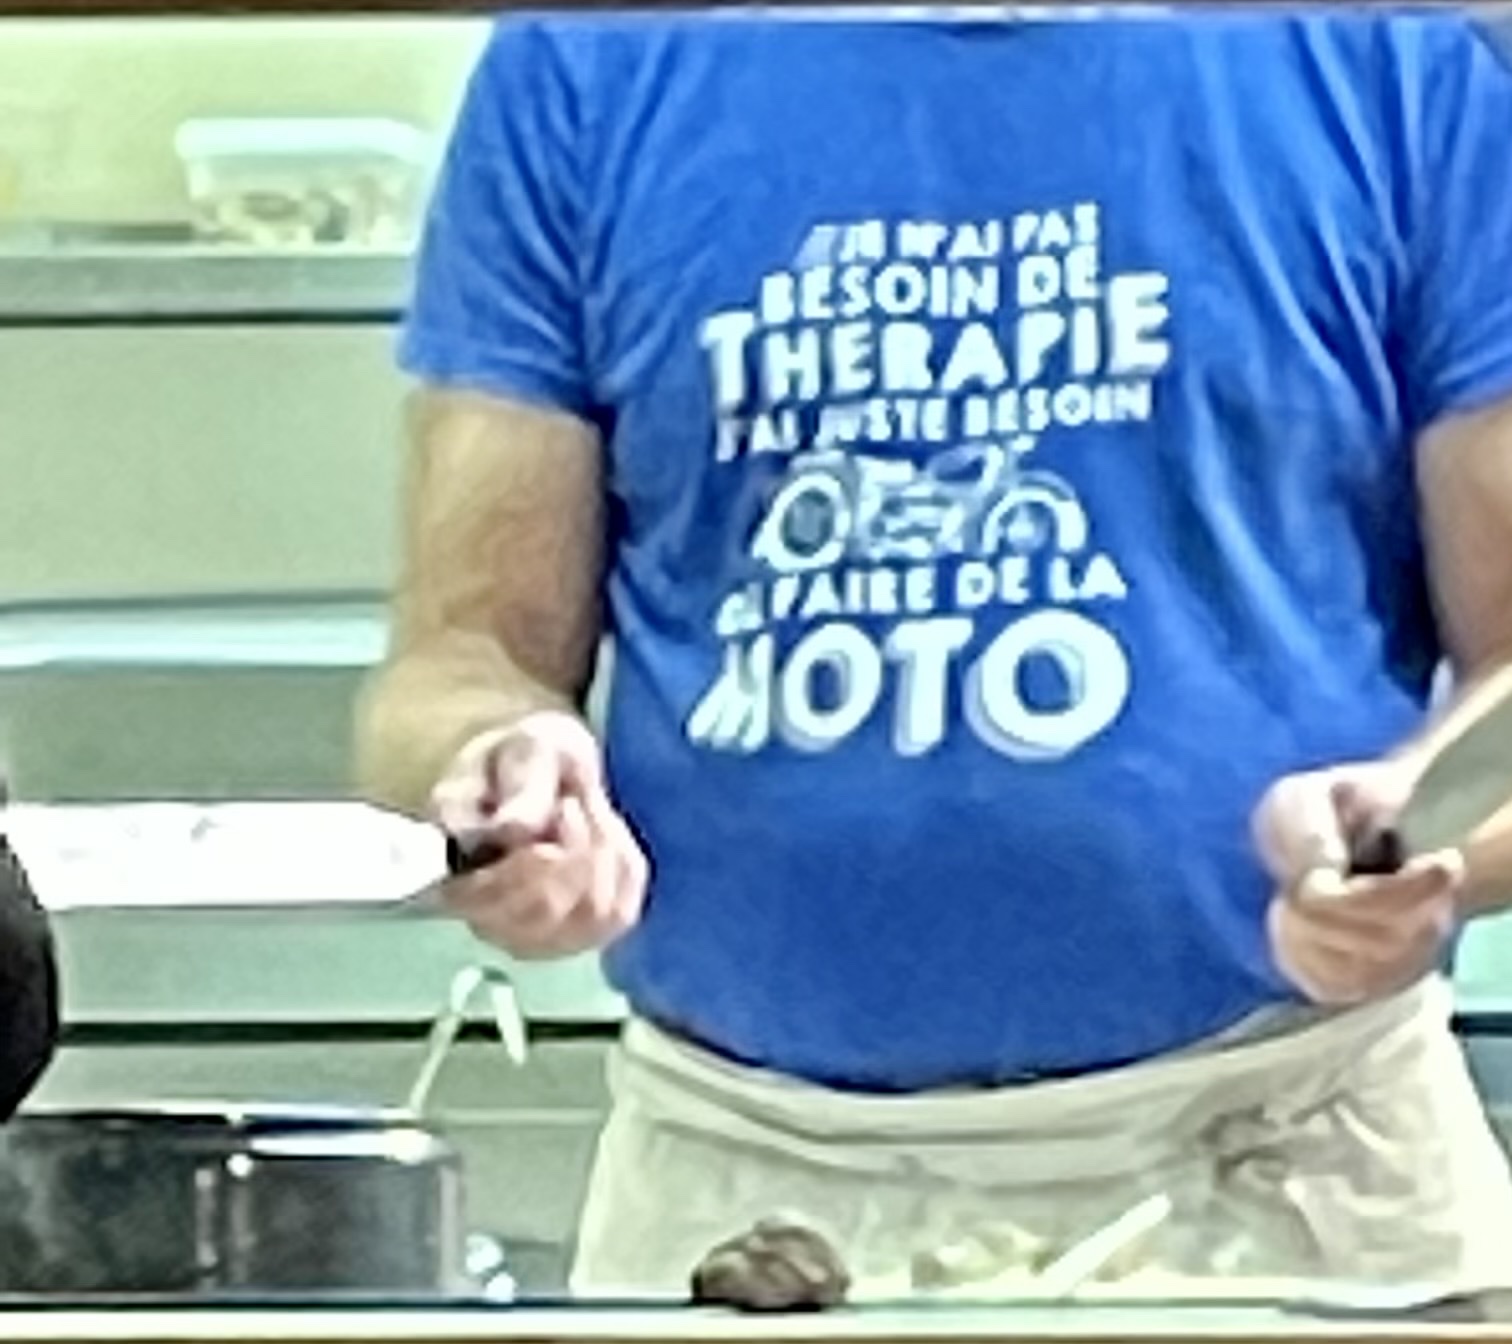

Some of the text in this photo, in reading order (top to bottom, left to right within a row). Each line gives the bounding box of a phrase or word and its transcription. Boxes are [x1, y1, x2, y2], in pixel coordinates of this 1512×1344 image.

[1012, 202, 1099, 252] PAS
[761, 246, 1101, 324] BESOIN DE
[699, 271, 1171, 413] THERAPIE
[962, 382, 1151, 438] BESOIN
[772, 566, 936, 620] FAIRE
[956, 556, 1031, 606] DE
[1049, 553, 1128, 601] LA
